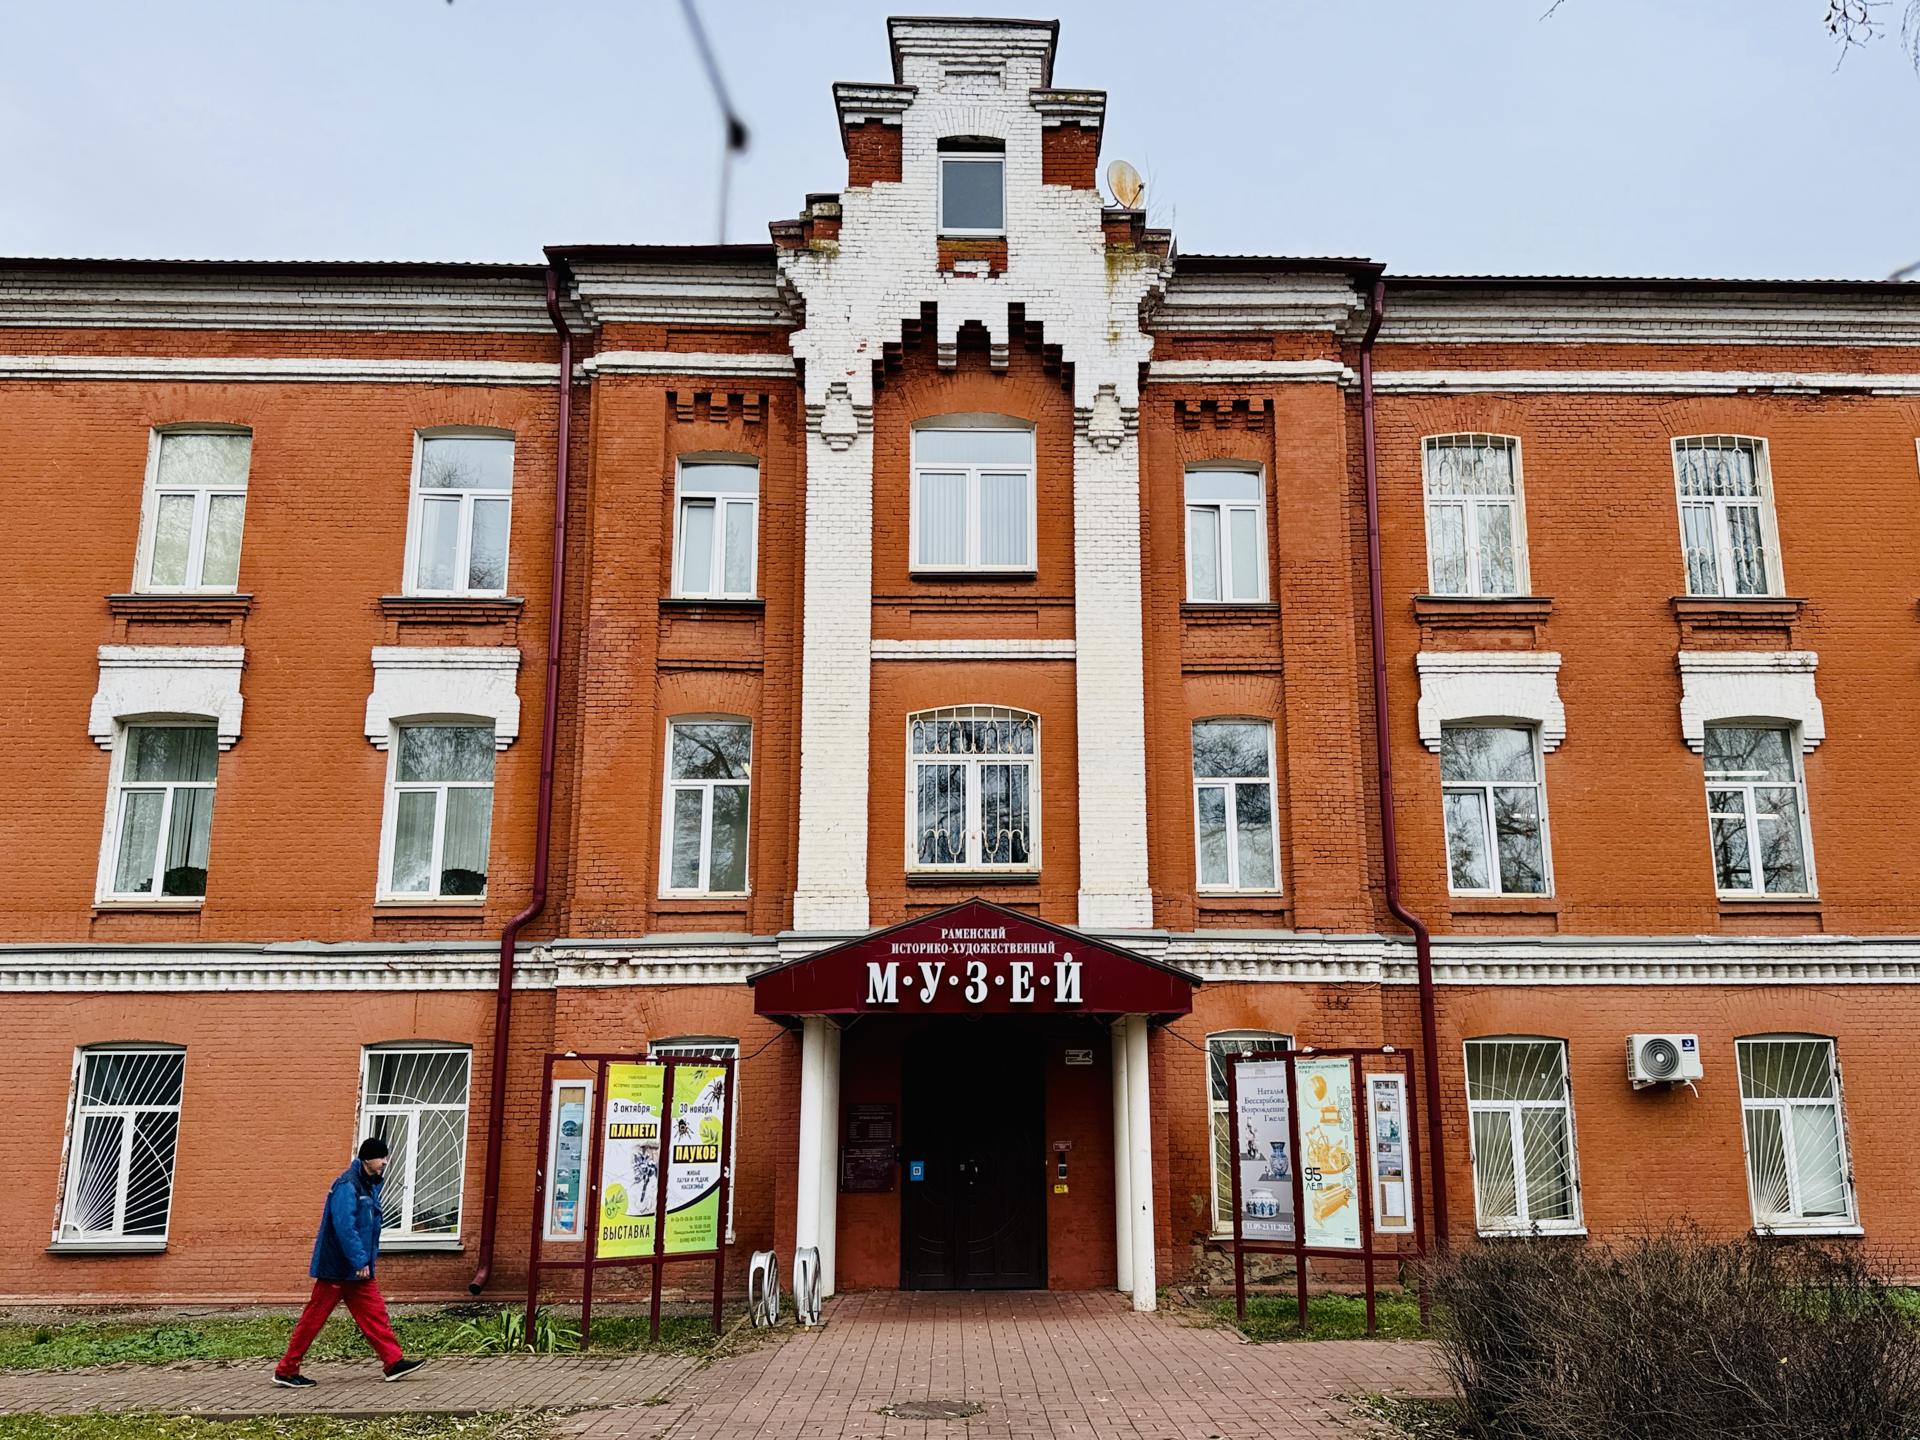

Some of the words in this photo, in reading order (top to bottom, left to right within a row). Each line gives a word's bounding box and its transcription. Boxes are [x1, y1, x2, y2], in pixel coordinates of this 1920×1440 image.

[941, 926, 1006, 939] РАМЕНСКИЙ
[891, 941, 1056, 955] ИСТОРИКО-ХУДОЖЕСТВЕННЫЙ
[1257, 1087, 1284, 1095] Наталья
[613, 1102, 619, 1113] 3
[620, 1102, 651, 1115] октября
[680, 1103, 688, 1113] 30
[690, 1104, 713, 1115] ноября
[610, 1124, 656, 1138] ПЛАНЕТА
[675, 1146, 717, 1162] ПАУКОВ
[1305, 1167, 1323, 1181] 95
[603, 1224, 650, 1240] ВЫСТАВКА
